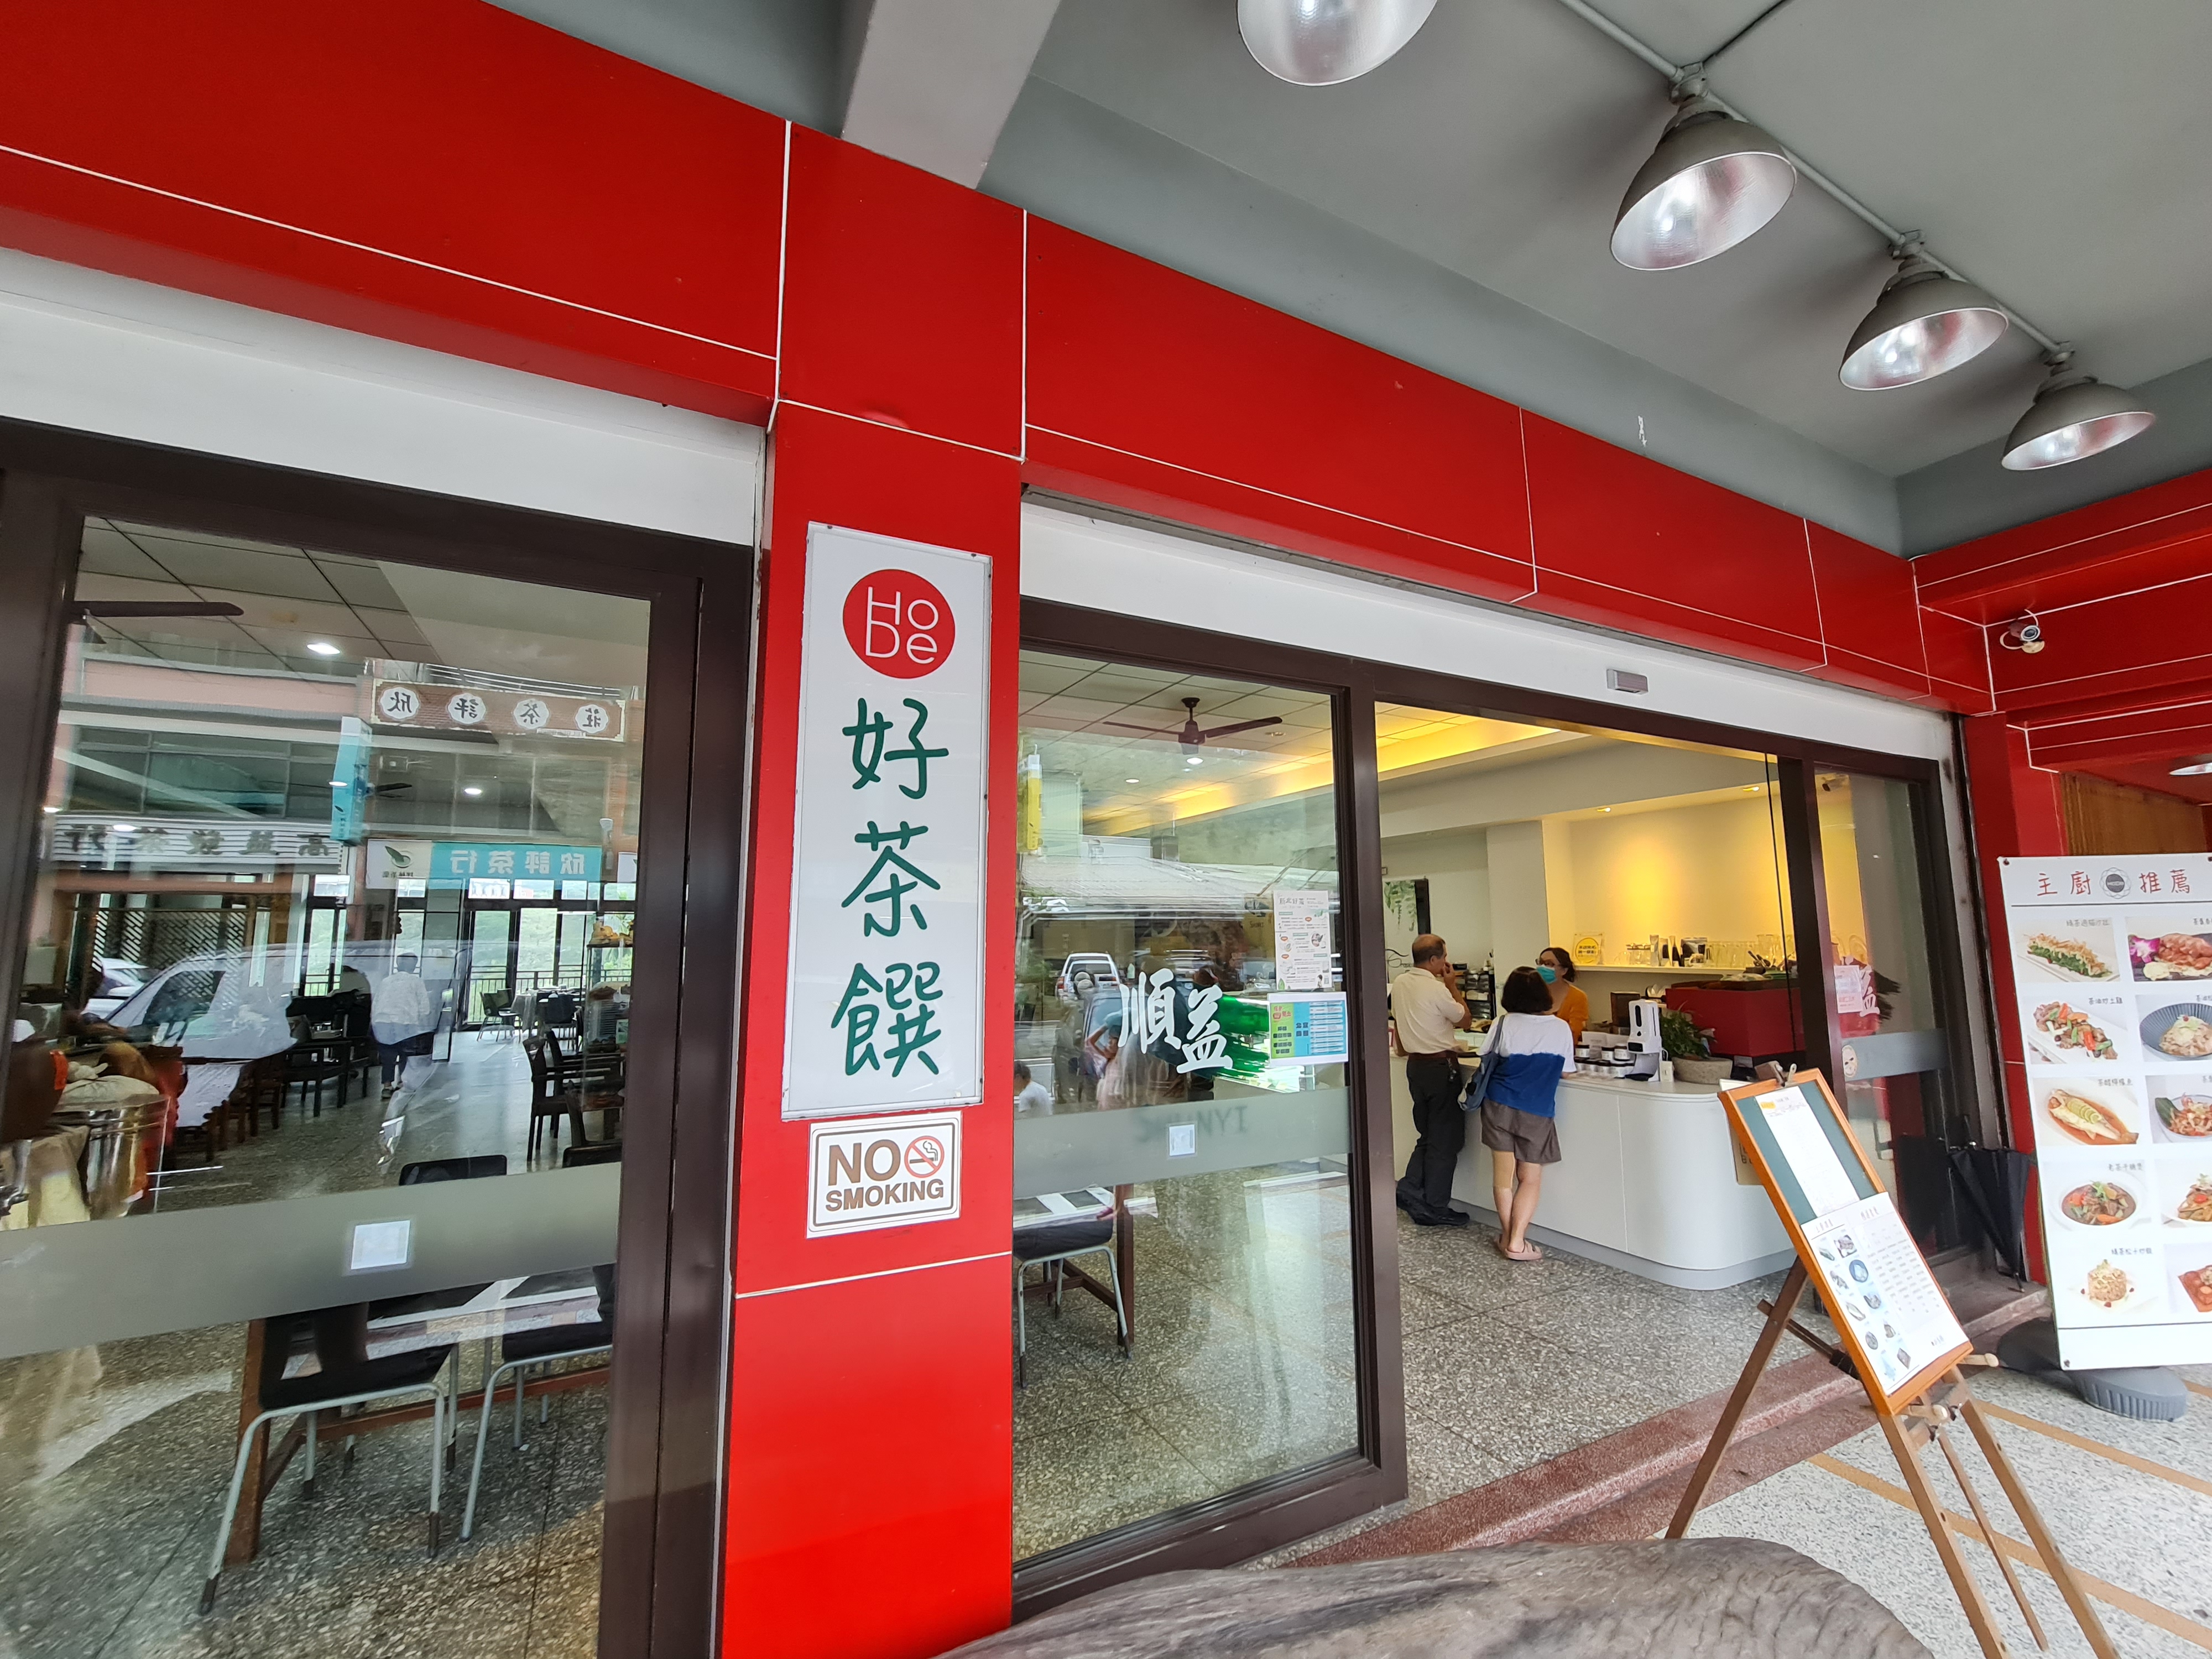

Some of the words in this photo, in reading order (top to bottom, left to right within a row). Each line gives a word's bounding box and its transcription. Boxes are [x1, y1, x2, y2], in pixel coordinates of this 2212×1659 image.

[2037, 871, 2091, 896] 主廚
[2138, 869, 2191, 894] 推薦
[1118, 968, 1234, 1074] 順益
[828, 1139, 901, 1186] NO
[826, 1178, 943, 1211] SMOKING
